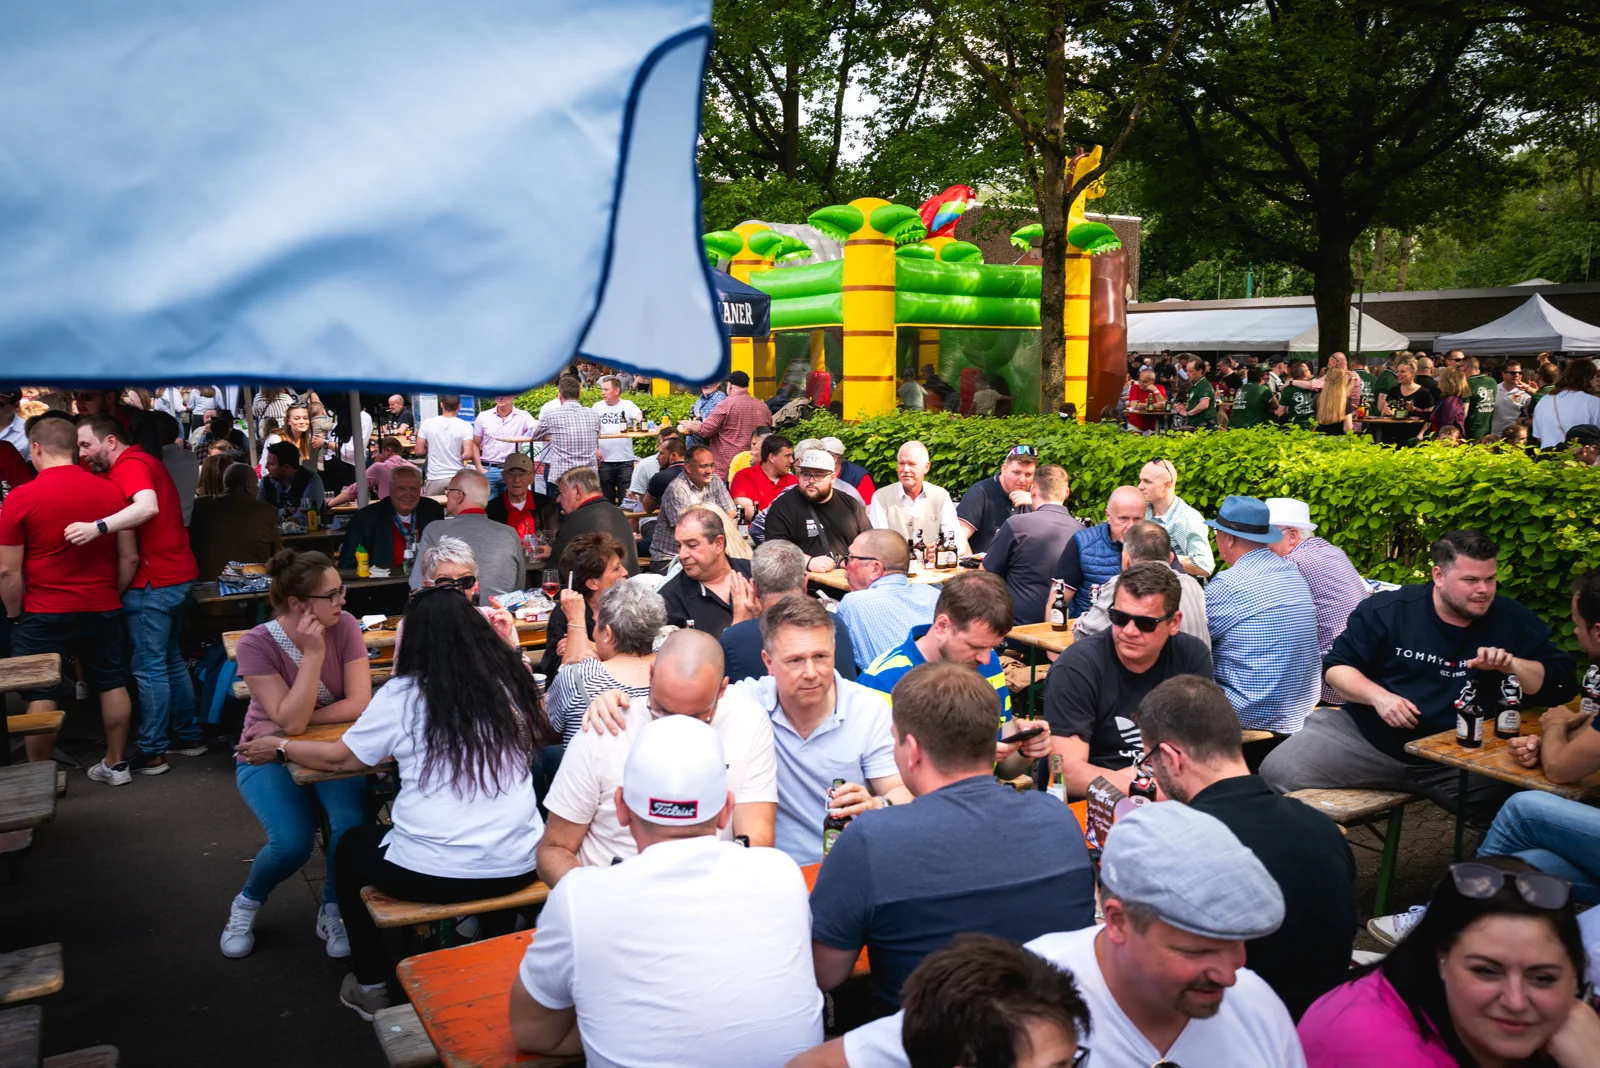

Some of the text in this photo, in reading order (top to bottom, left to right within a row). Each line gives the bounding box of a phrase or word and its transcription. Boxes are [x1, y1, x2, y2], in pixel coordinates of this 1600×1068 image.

[717, 301, 754, 325] ANER
[1395, 647, 1444, 666] TOMMY
[651, 802, 696, 817] Titleist
